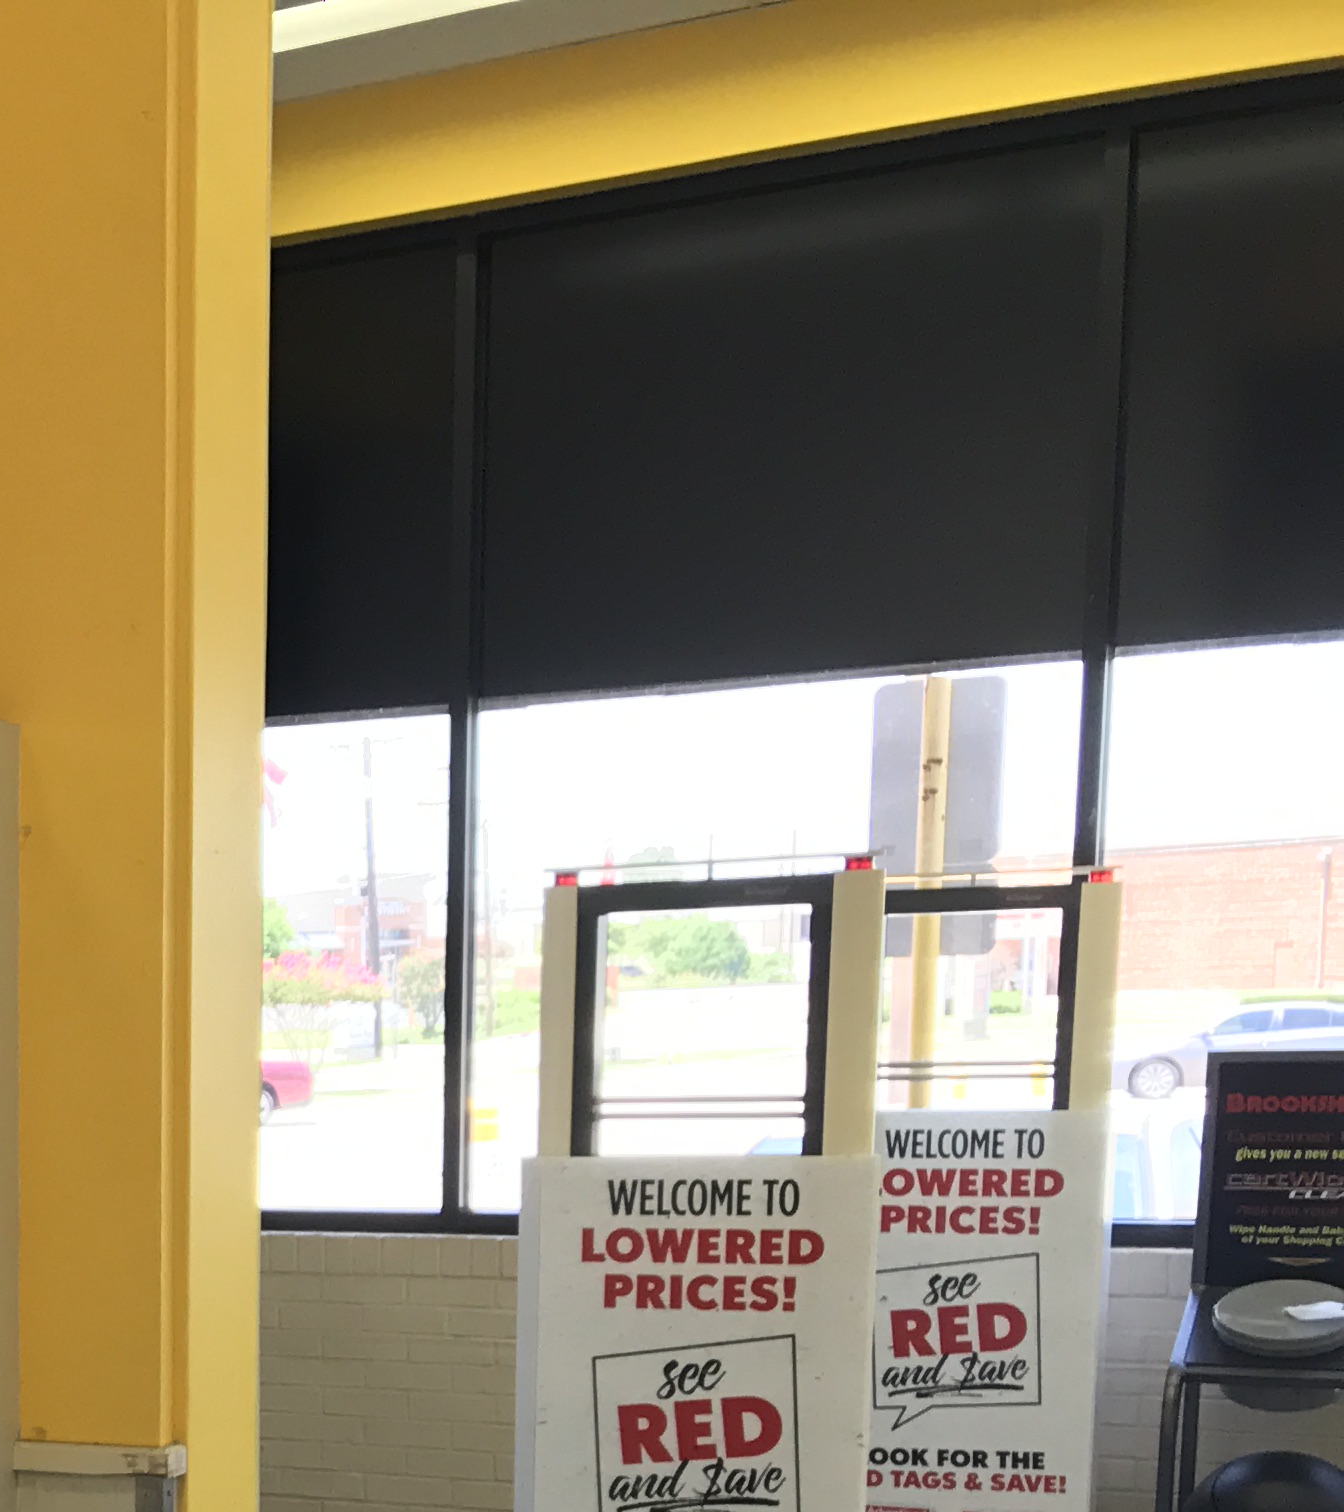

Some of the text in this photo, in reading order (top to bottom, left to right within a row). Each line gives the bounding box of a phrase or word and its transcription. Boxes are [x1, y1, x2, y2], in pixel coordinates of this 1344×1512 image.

[885, 1129, 1045, 1160] WELCOME TO
[1235, 1146, 1329, 1163] gives you a new
[608, 1178, 800, 1217] WELCOME TO
[879, 1168, 1065, 1198] OWERED
[880, 1205, 1042, 1236] PRICES!
[1299, 1225, 1320, 1235] and
[580, 1227, 825, 1265] LOWERED
[1241, 1235, 1254, 1244] of
[1256, 1236, 1281, 1246] your
[1283, 1235, 1333, 1247] Shopping
[603, 1274, 798, 1313] PRICES!
[922, 1272, 981, 1306] see
[890, 1302, 1028, 1359] RED
[656, 1358, 727, 1400] see
[881, 1352, 949, 1388] and
[617, 1395, 783, 1466] RED
[866, 1447, 1045, 1470] OOK FOR THE
[608, 1457, 690, 1502] and
[890, 1470, 957, 1490] TAGS
[964, 1472, 983, 1491] &
[990, 1473, 1067, 1494] SAVE!
